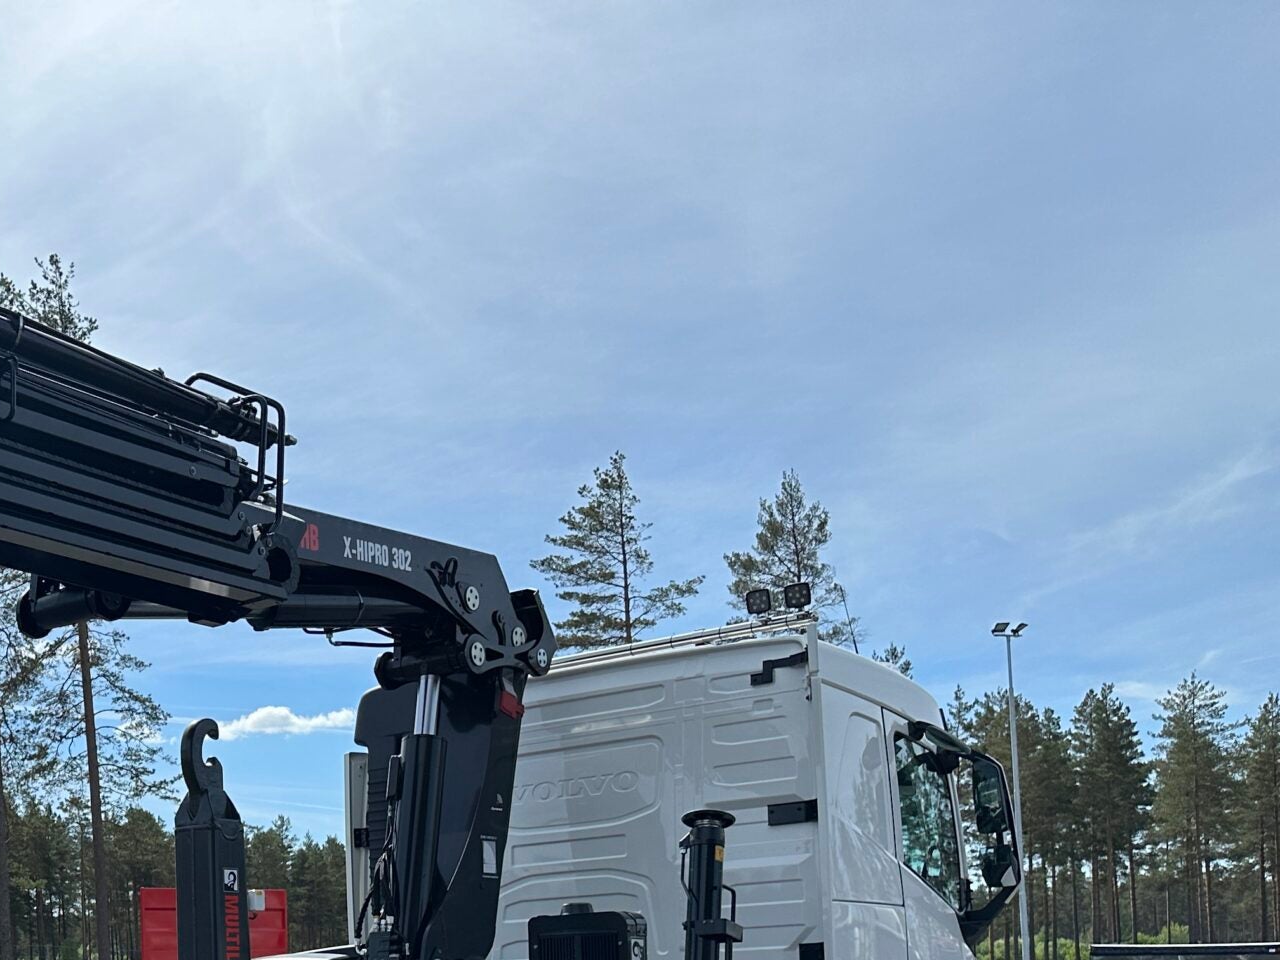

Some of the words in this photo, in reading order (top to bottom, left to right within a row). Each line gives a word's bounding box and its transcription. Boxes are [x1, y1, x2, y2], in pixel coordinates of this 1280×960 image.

[343, 536, 389, 567] X-HIPRO
[391, 547, 412, 572] 302
[513, 770, 639, 805] VOLVO
